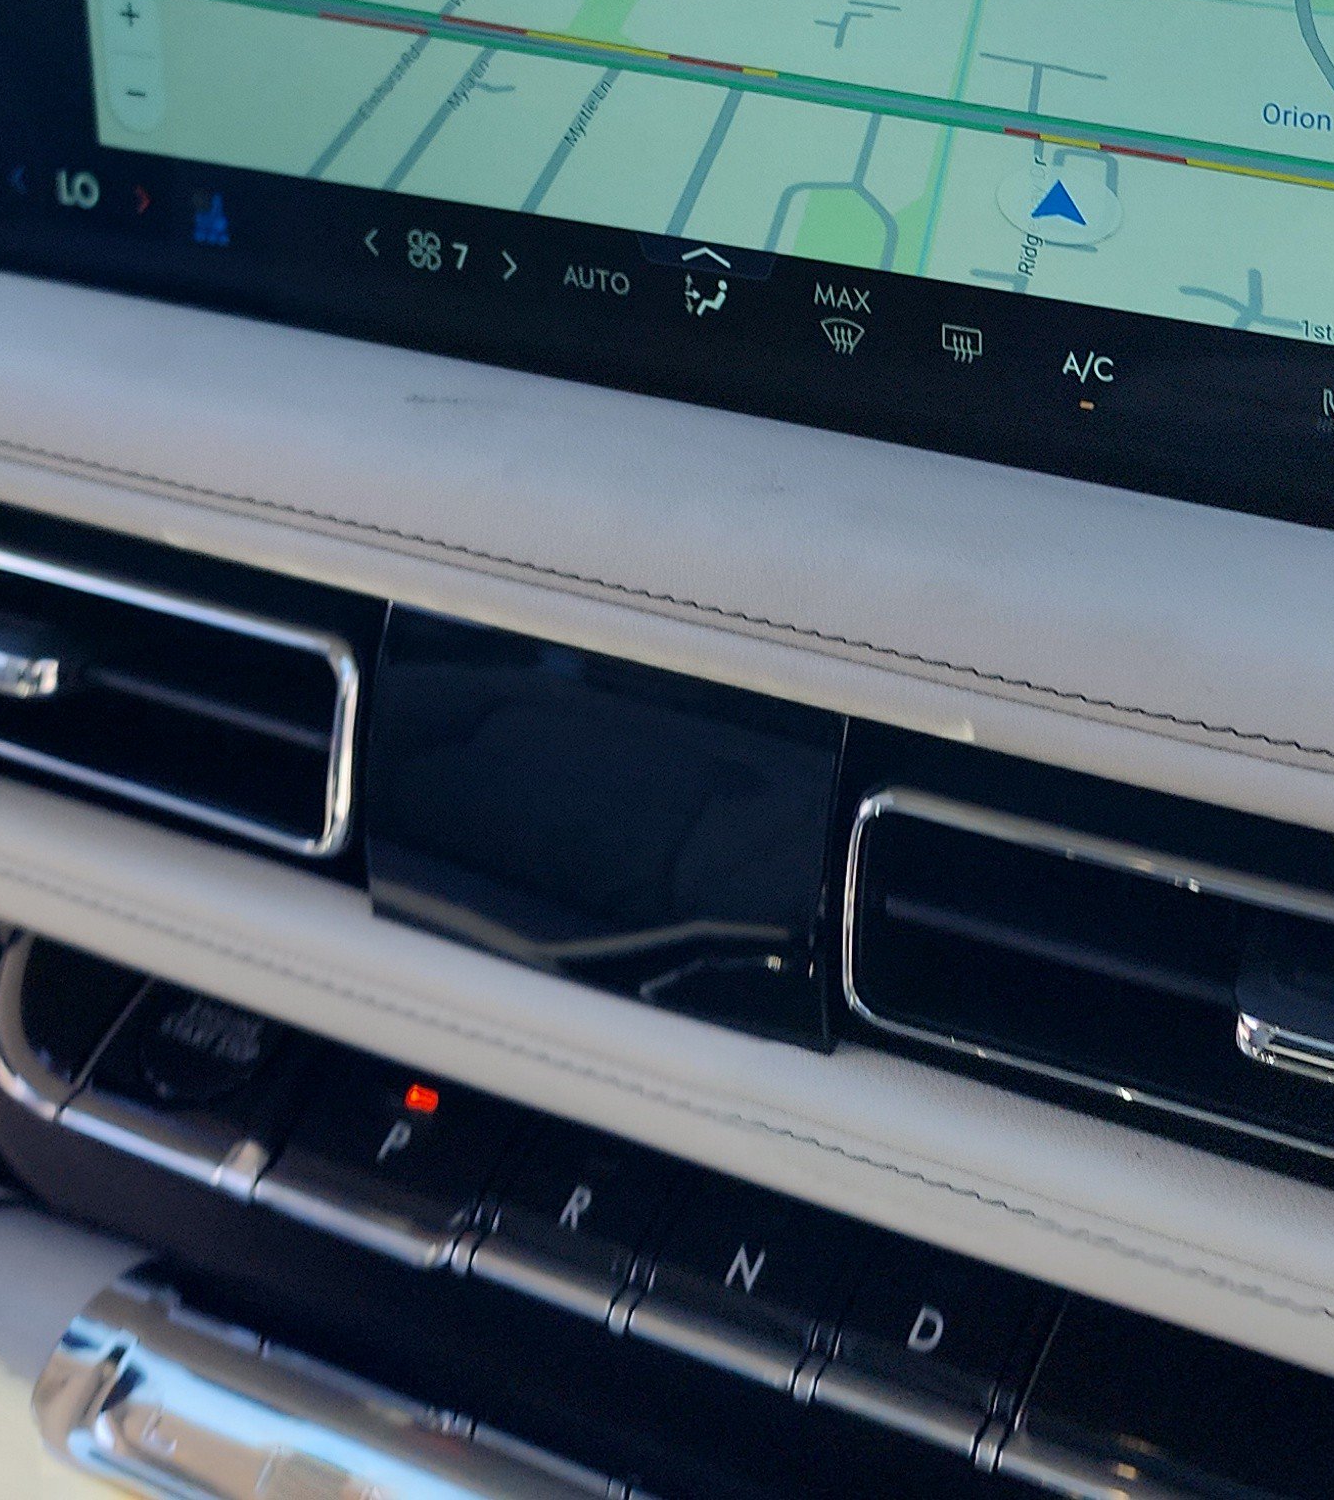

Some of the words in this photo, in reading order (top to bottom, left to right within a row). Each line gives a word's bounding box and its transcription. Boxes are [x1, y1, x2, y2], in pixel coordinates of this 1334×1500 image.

[563, 98, 599, 148] Myrtle
[592, 79, 613, 102] Ln
[1262, 101, 1332, 133] Orion
[55, 168, 101, 211] LO
[451, 244, 468, 270] 7
[563, 262, 631, 296] AUTO
[813, 282, 872, 316] MAX
[1301, 318, 1331, 344] 1st
[1062, 350, 1115, 384] A/C
[375, 1120, 411, 1163] P
[560, 1184, 593, 1229] R
[724, 1243, 768, 1293] N
[907, 1307, 945, 1353] D
